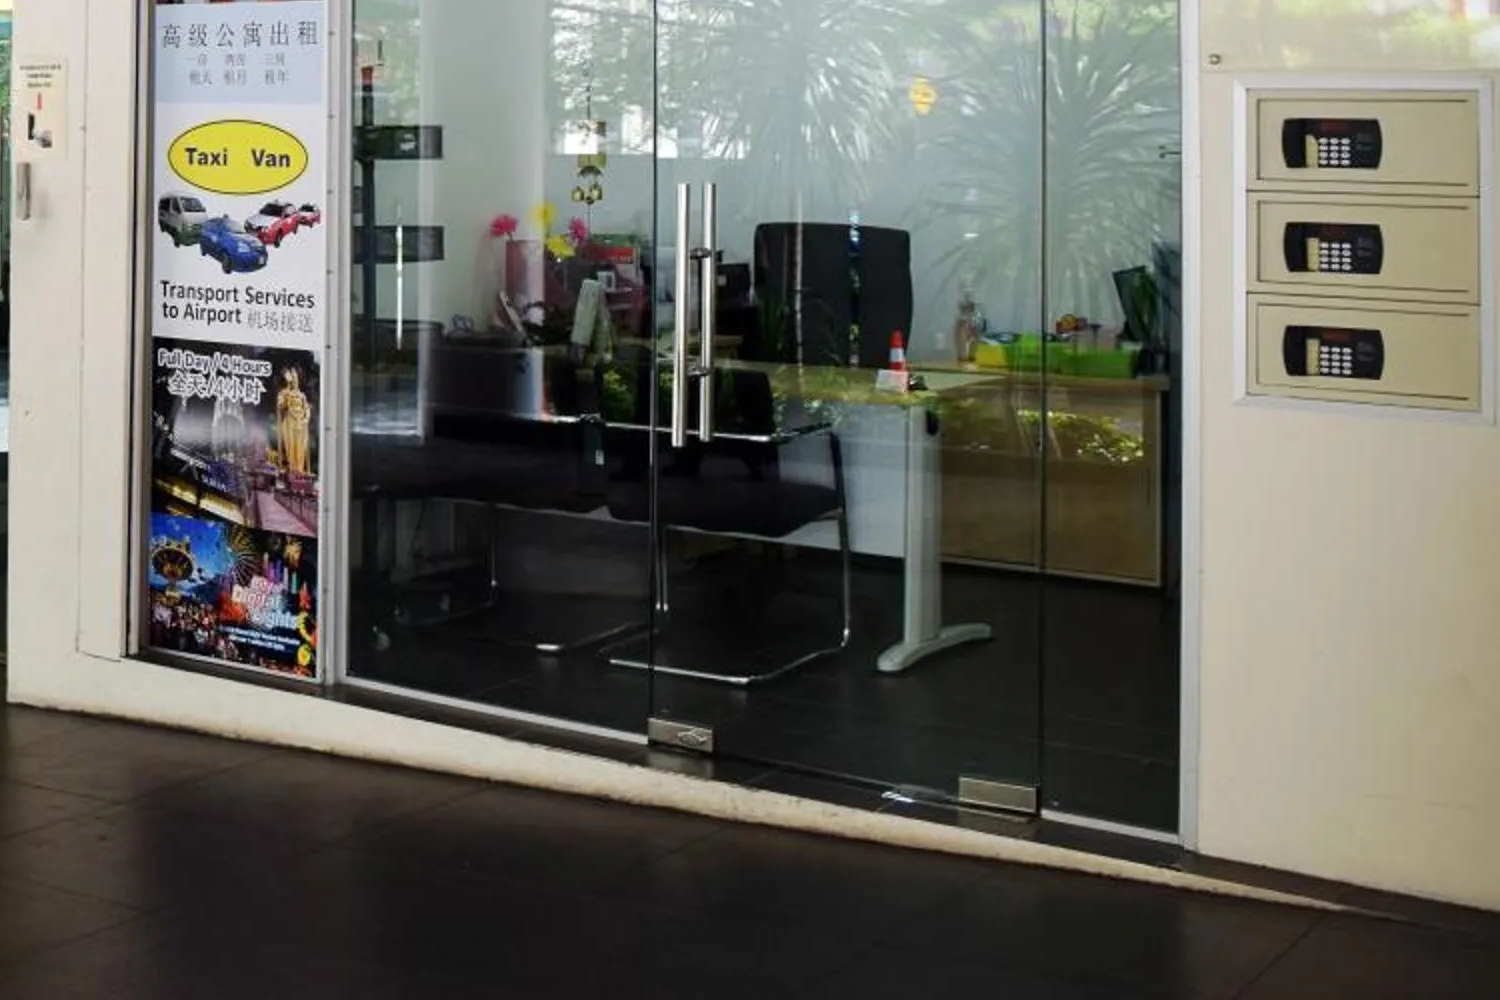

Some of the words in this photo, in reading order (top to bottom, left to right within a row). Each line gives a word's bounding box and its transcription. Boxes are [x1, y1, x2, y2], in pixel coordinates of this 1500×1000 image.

[162, 20, 319, 49] 高级公寓出租
[184, 146, 228, 166] Taxi
[251, 148, 291, 168] Van
[160, 280, 239, 305] Transport
[245, 285, 315, 309] Services
[162, 301, 179, 319] to
[183, 303, 242, 326] Airport
[231, 355, 272, 377] Hours
